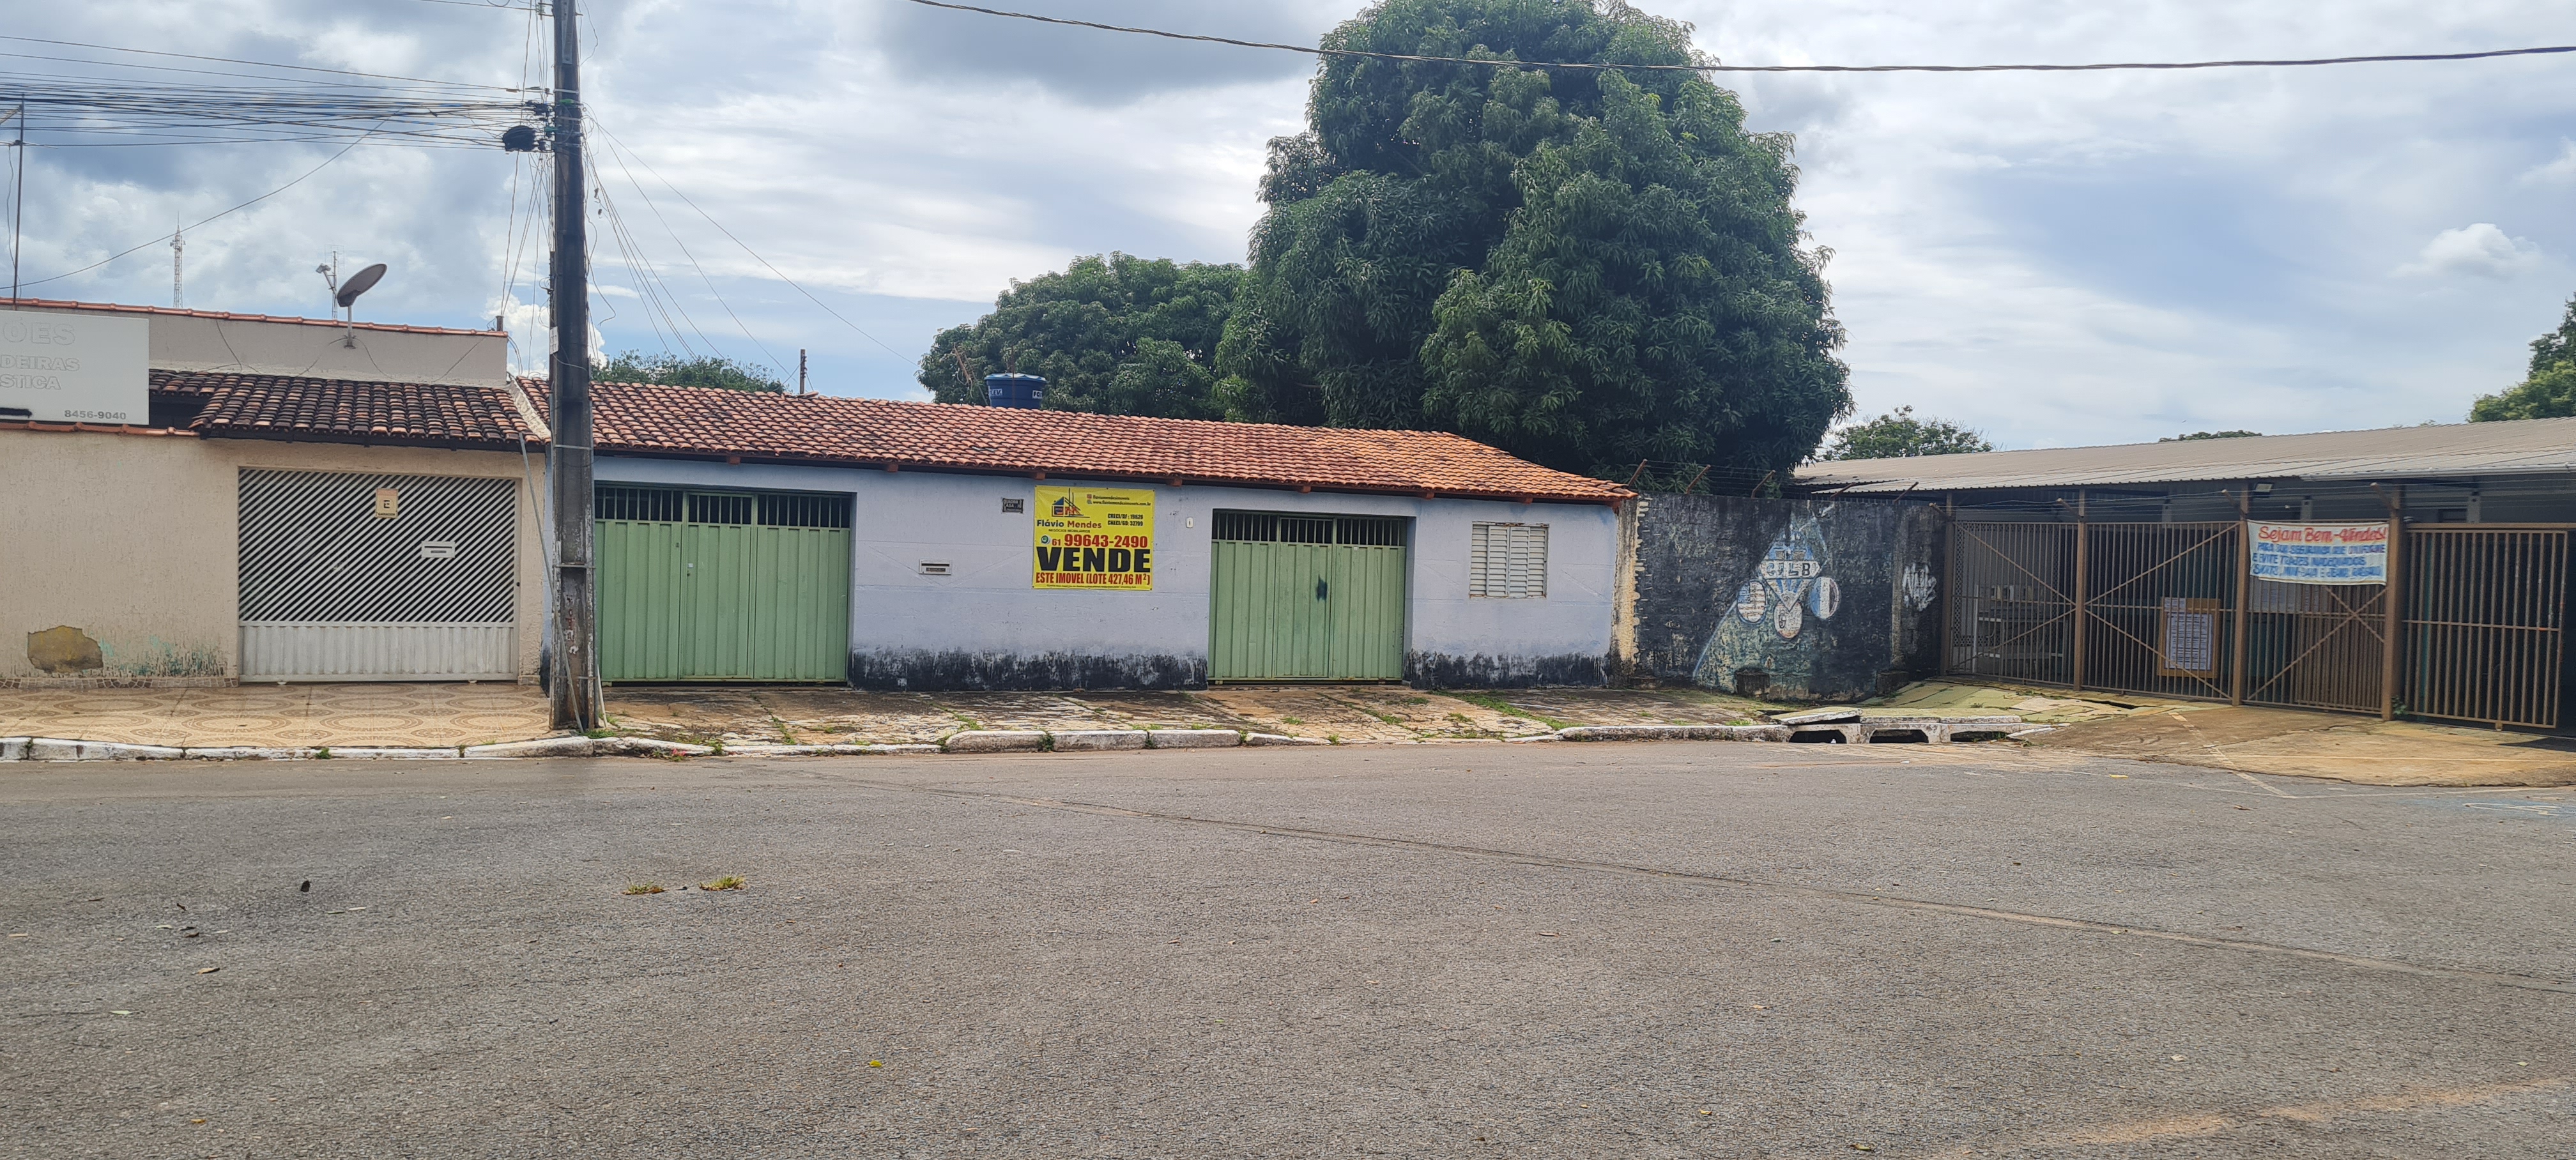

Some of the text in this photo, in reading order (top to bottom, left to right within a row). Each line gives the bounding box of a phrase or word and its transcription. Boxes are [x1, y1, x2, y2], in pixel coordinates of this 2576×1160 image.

[0, 354, 80, 371] DEIRAS
[0, 374, 61, 390] STICA
[65, 410, 126, 420] 8456-9040
[1037, 519, 1064, 528] Flávio
[1052, 534, 1148, 547] 61 99643-2490
[2258, 526, 2302, 543] Sejam
[1036, 546, 1151, 572] VENDE
[2252, 553, 2258, 562] E
[1036, 572, 1054, 583] ESTE
[1056, 573, 1084, 584] IMOVEL
[1086, 574, 1107, 584] (LOTE
[1108, 574, 1133, 586] 427,46
